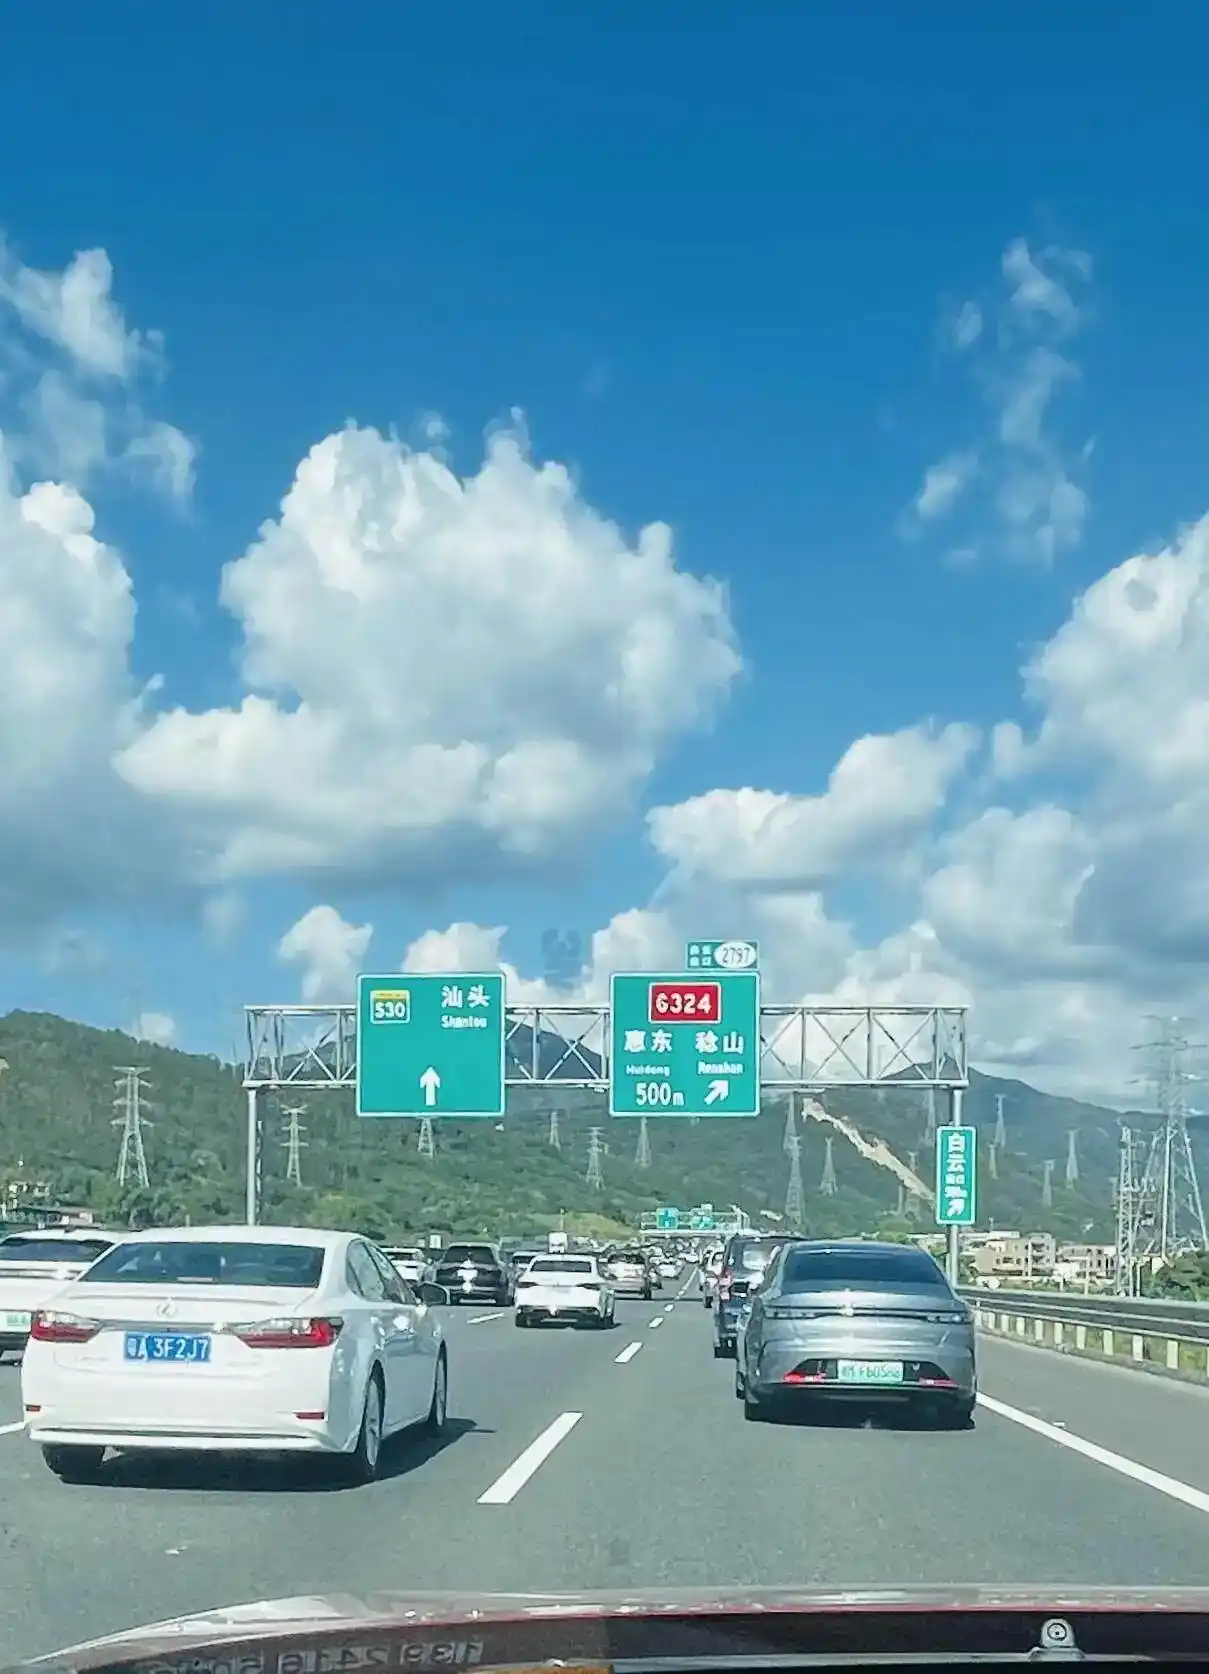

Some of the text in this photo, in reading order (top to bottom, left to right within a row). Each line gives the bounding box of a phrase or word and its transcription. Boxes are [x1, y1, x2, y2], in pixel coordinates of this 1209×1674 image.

[441, 985, 490, 1009] 汕头
[623, 1028, 673, 1054] 惠东
[635, 1081, 685, 1106] 500m
